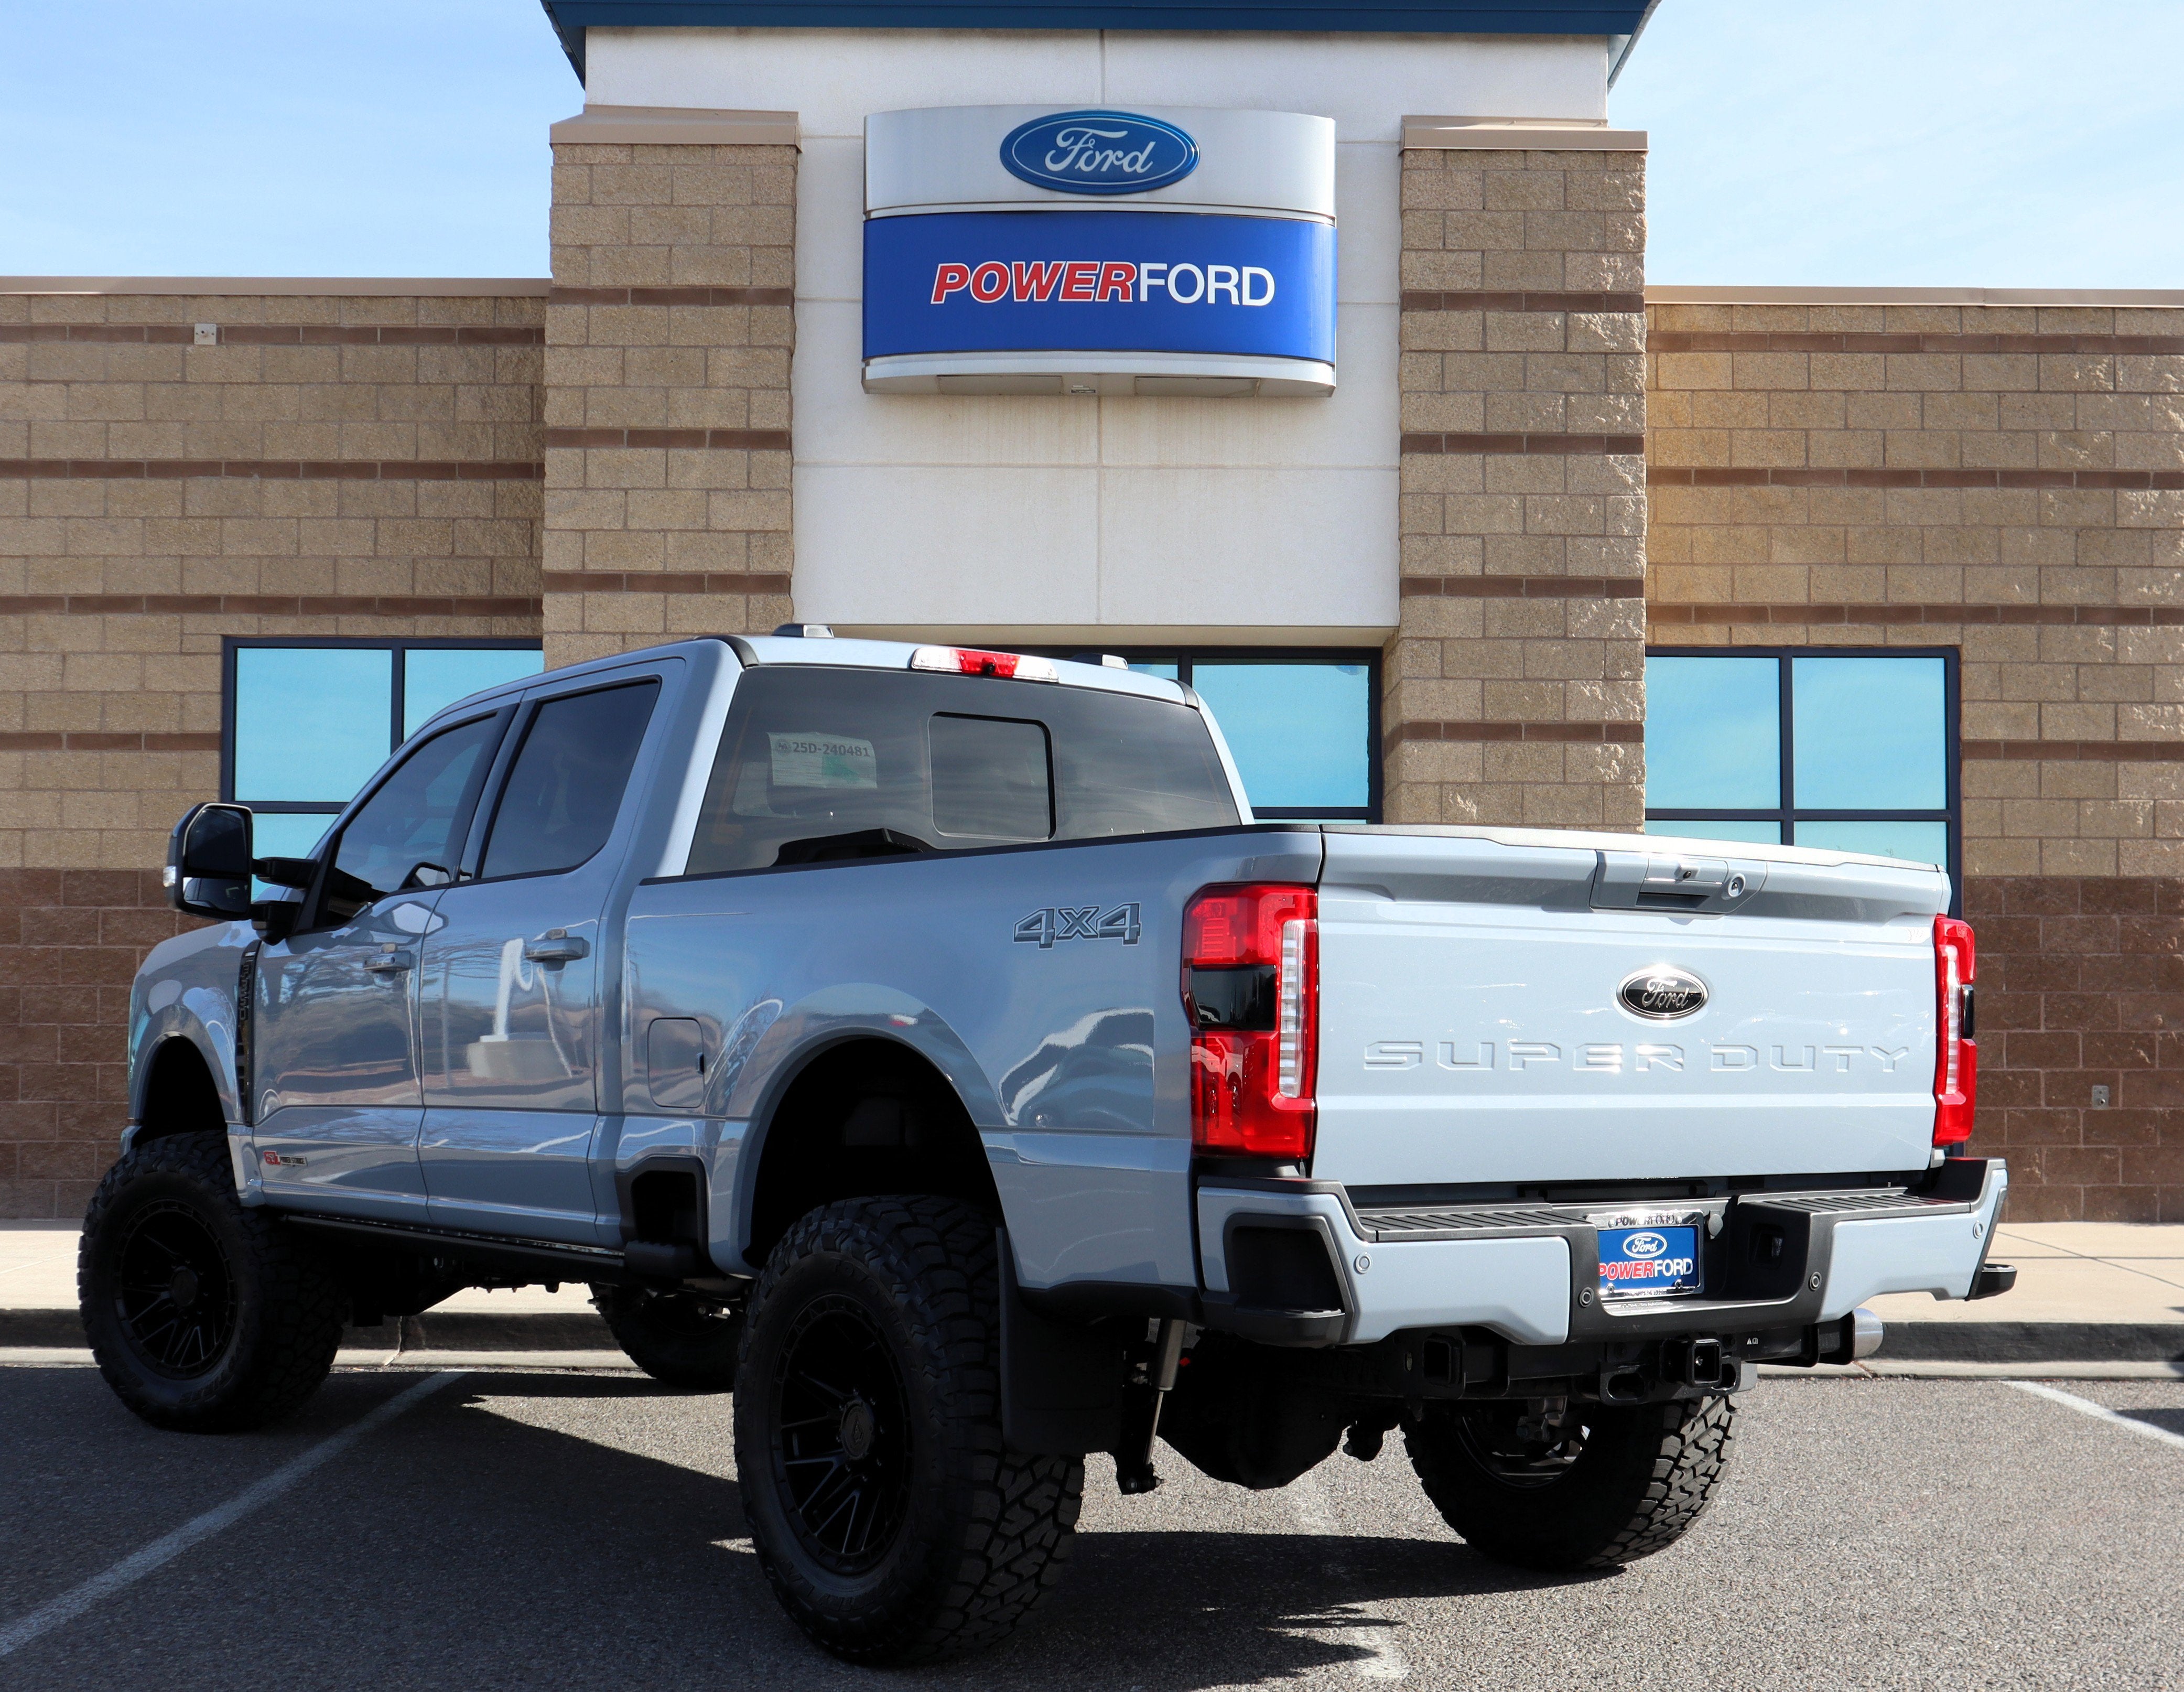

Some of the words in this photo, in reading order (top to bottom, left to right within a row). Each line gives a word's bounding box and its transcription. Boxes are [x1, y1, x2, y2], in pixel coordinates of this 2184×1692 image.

[1045, 126, 1156, 175] Ford
[930, 261, 1276, 307] POWERFORD
[792, 741, 871, 758] 25D-240481
[1641, 978, 1690, 1009] Ford
[1363, 1041, 1685, 1073] SUPER
[1711, 1043, 1910, 1073] DUTY
[1631, 1236, 1658, 1253] Ford
[1599, 1258, 1693, 1280] POWERFORD
